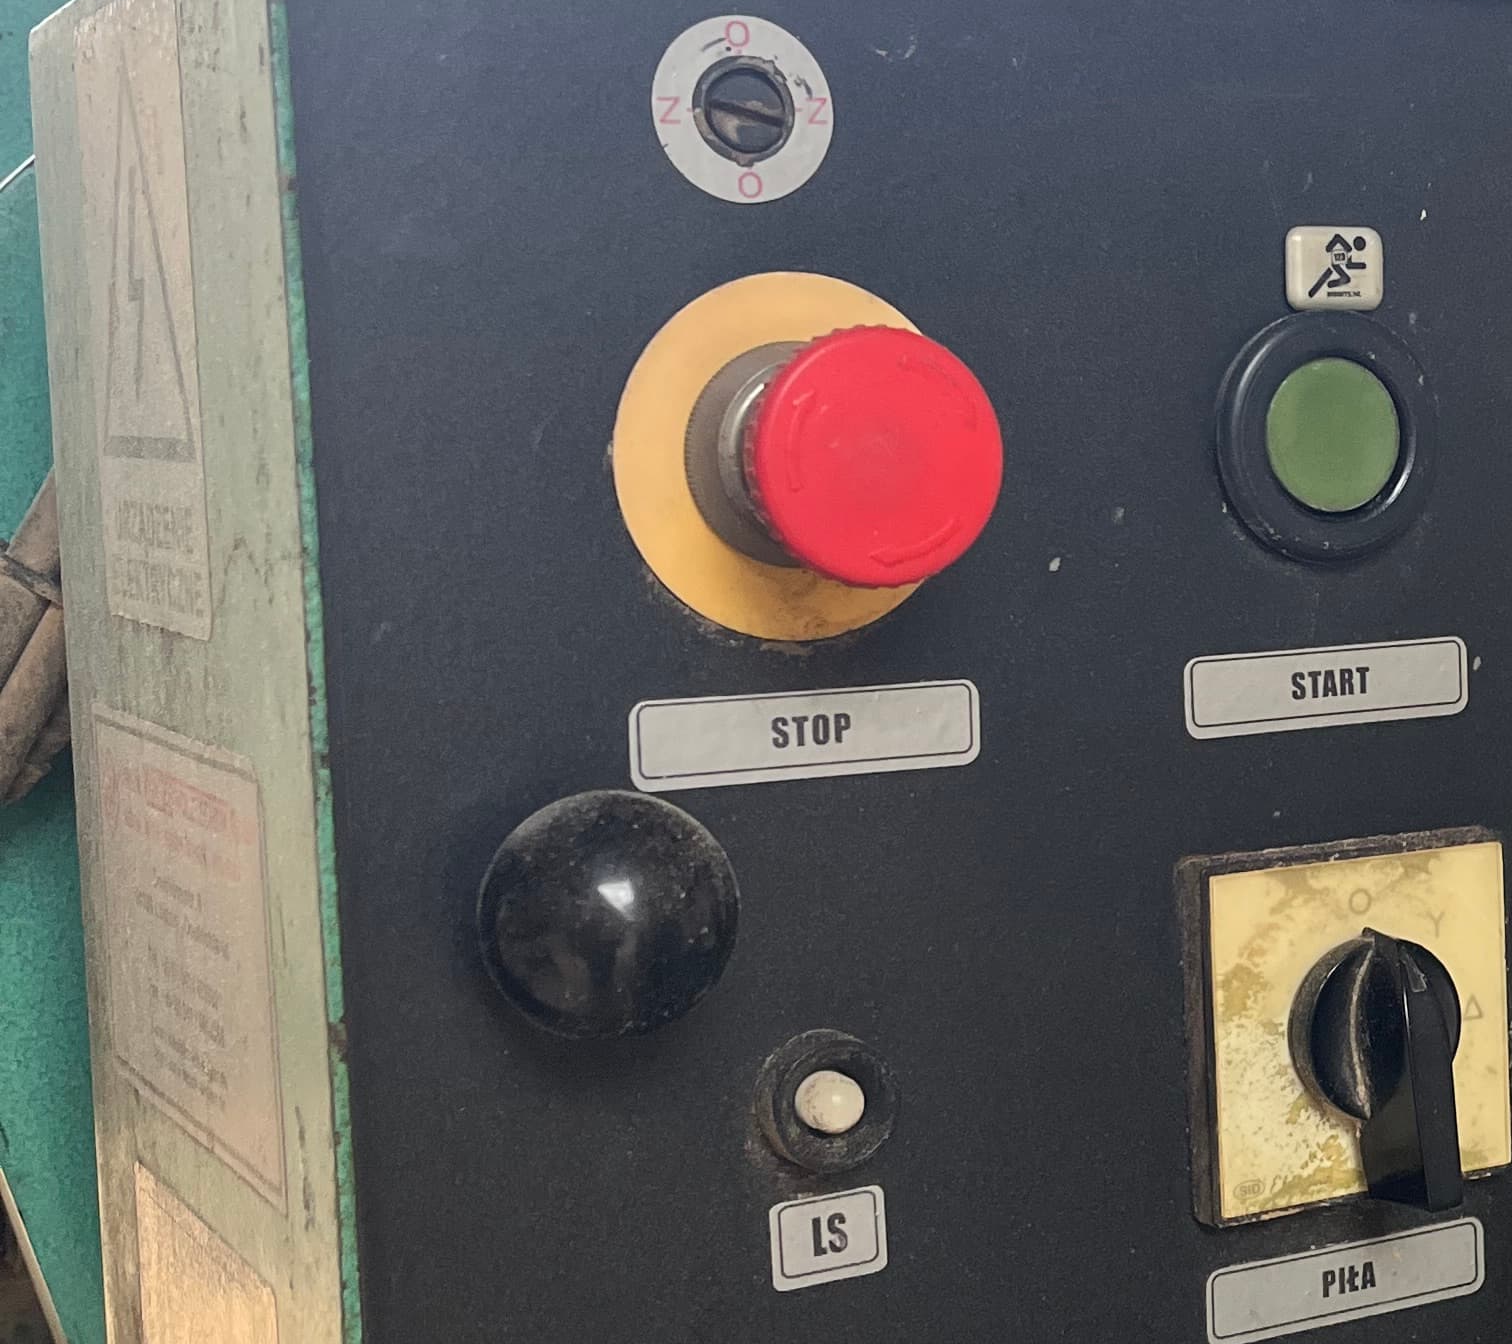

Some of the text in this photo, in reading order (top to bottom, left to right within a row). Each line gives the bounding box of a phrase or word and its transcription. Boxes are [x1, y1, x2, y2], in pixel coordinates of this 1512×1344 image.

[1291, 666, 1370, 700] START
[771, 713, 851, 748] STOP
[1240, 1183, 1261, 1197] SID
[1321, 1260, 1376, 1298] PIŁA
